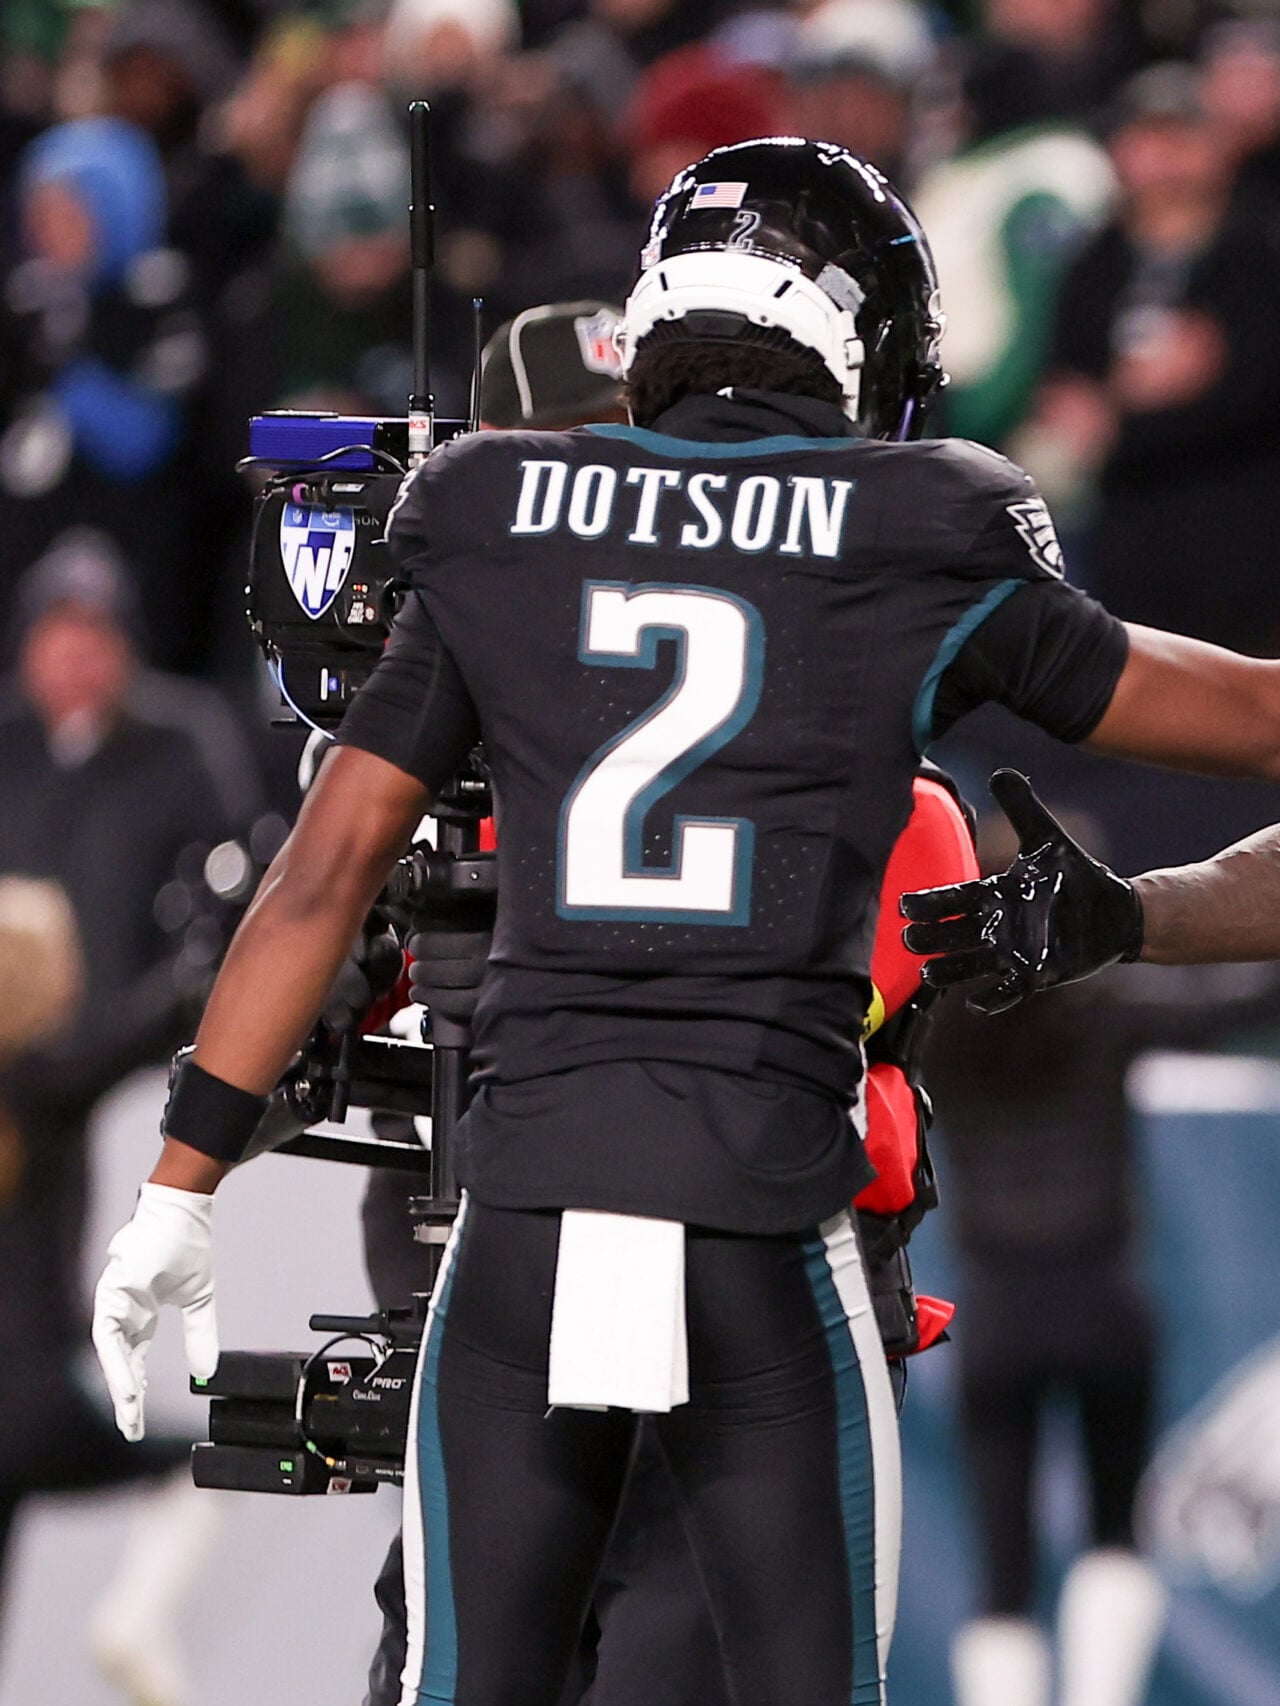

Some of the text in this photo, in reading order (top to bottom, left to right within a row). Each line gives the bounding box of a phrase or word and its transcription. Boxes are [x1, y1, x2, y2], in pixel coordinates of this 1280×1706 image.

[725, 210, 763, 253] 2
[509, 459, 854, 559] DOTSON
[556, 579, 767, 927] 2
